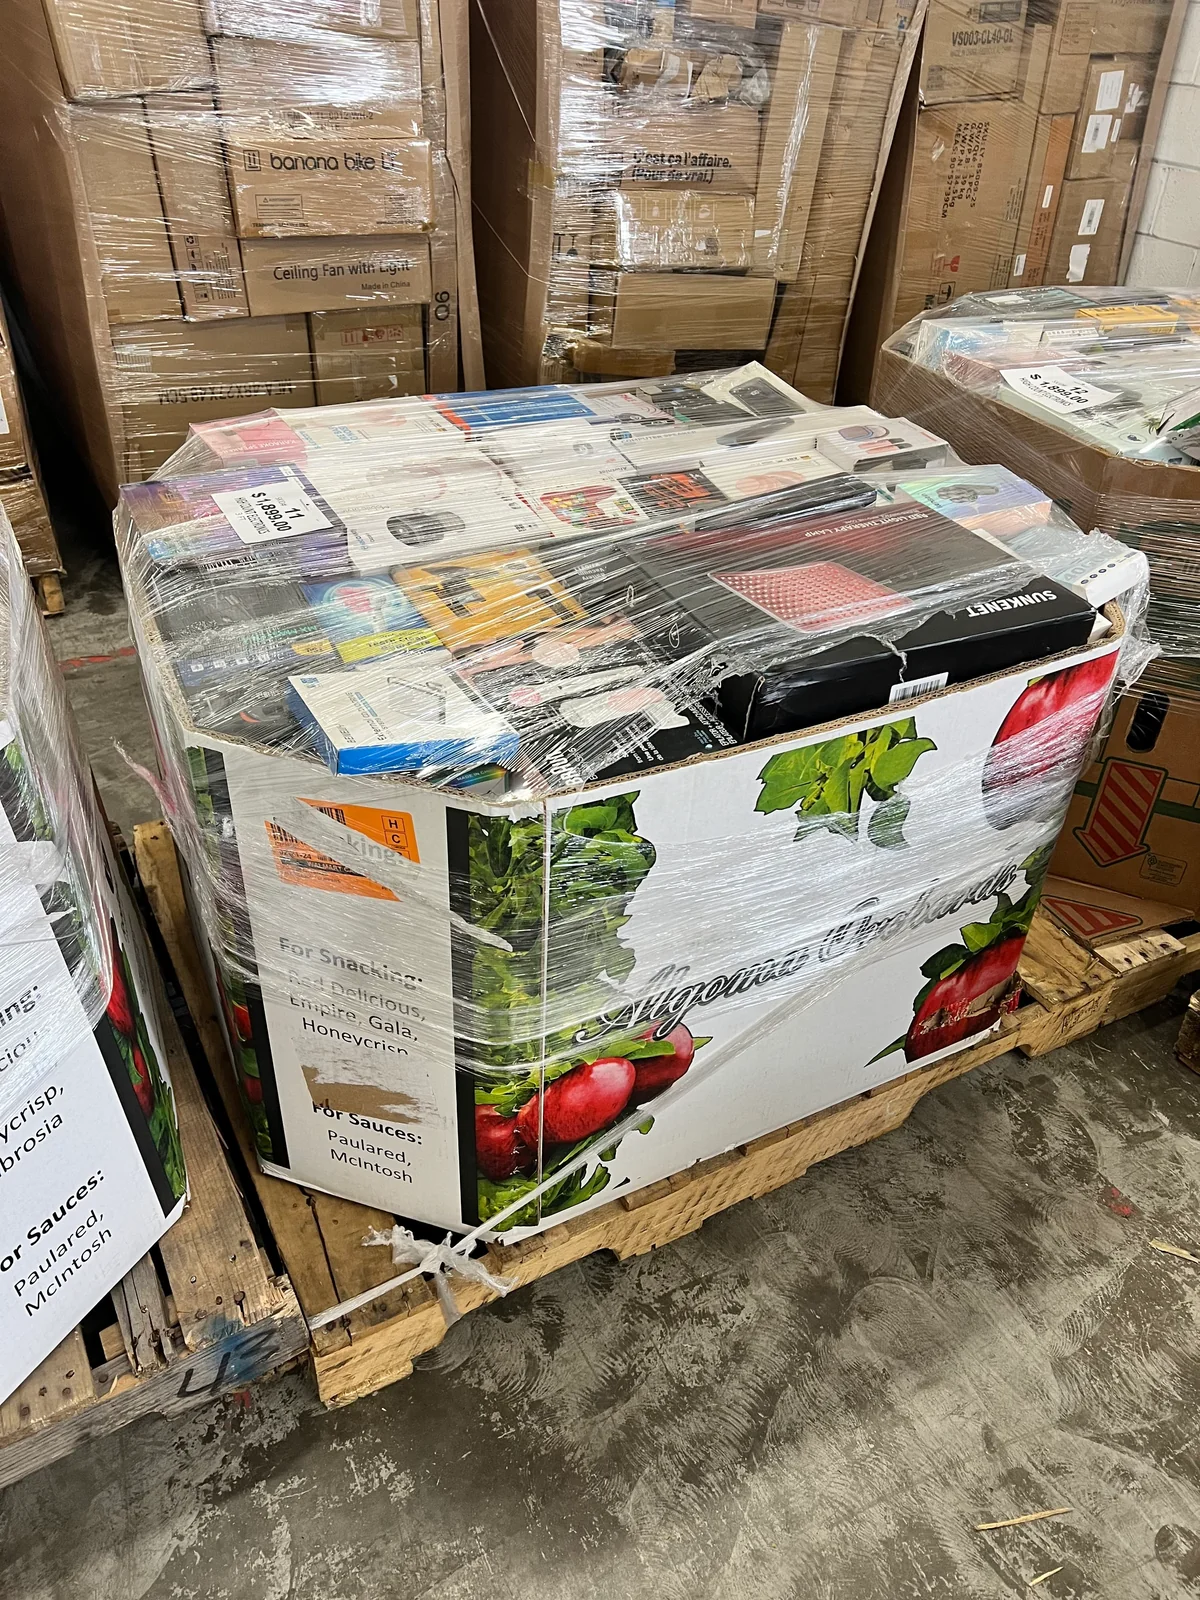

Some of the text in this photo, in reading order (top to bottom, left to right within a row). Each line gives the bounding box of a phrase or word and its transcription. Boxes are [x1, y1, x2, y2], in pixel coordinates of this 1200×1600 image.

[270, 153, 339, 170] banana
[344, 152, 376, 171] bike
[684, 152, 732, 169] l'affaire.
[684, 169, 714, 184] vrai.)
[273, 265, 319, 282] Ceiling
[323, 264, 345, 277] Fan
[349, 261, 375, 275] with
[1039, 381, 1089, 404] 1,899.00
[255, 498, 292, 532] 1,899.00
[285, 507, 305, 519] 11
[835, 520, 879, 533] THERAPY
[880, 515, 908, 524] LIGHT
[805, 528, 833, 538] LAMP
[966, 590, 1058, 618] SUNKENET
[708, 727, 729, 746] EPILATOR
[546, 750, 583, 787] BRAUN
[389, 819, 398, 829] H
[391, 834, 401, 844] C
[278, 936, 424, 991] For Snacking:
[572, 863, 1017, 1045] Algoma Orchards
[288, 969, 426, 1022] Red Delicious,
[289, 993, 418, 1042] Empire, Gala,
[0, 1086, 64, 1143] ycrisp,
[312, 1102, 423, 1145] For Sauces:
[0, 1114, 63, 1176] brosia
[327, 1129, 412, 1166] Paulared,
[330, 1148, 413, 1184] McIntosh
[26, 1169, 105, 1246] Sauces:
[0, 1246, 22, 1272] or
[14, 1211, 105, 1297] Paulared,
[25, 1229, 112, 1317] McIntosh
